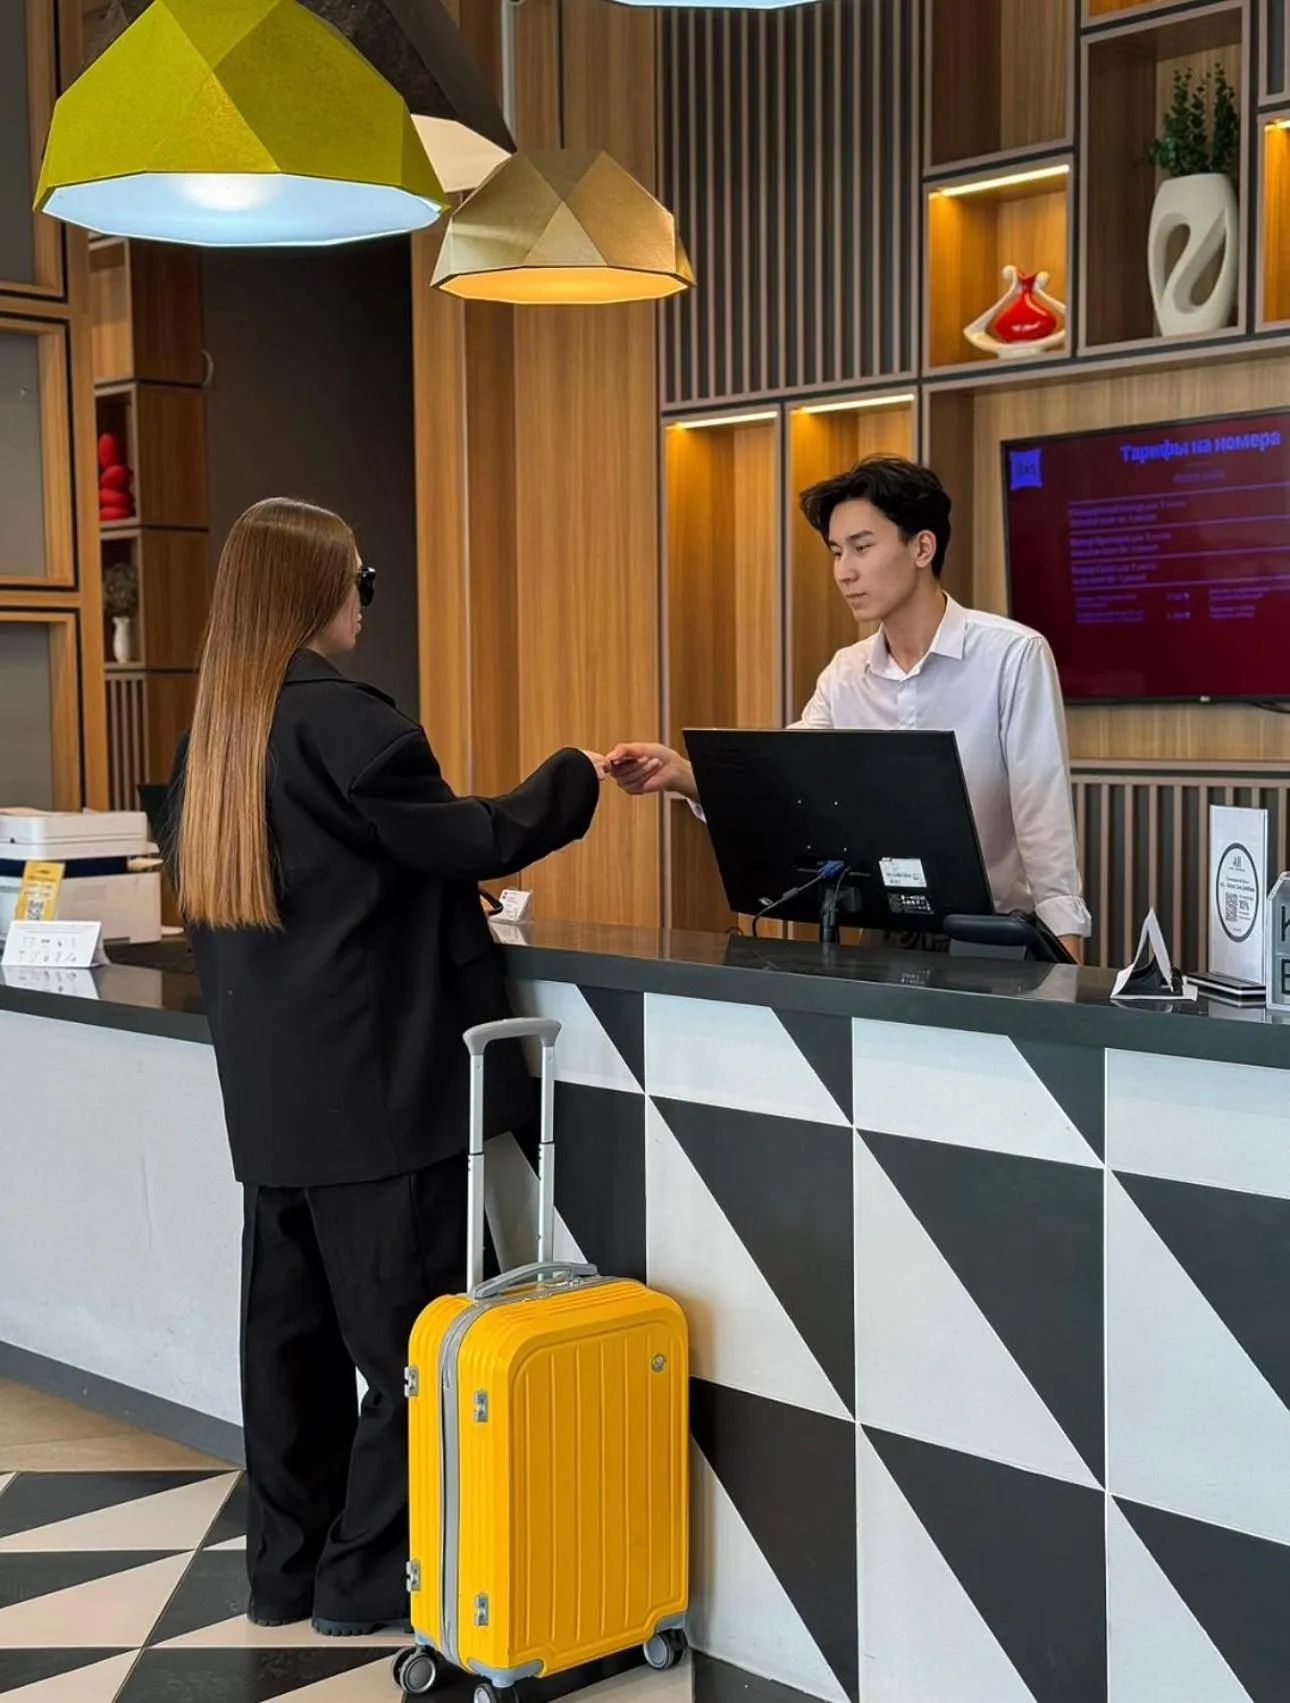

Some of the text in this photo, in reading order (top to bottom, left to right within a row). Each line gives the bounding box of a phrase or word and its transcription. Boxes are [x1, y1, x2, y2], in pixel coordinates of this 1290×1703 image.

[1120, 431, 1281, 464] Тарифы на номера
